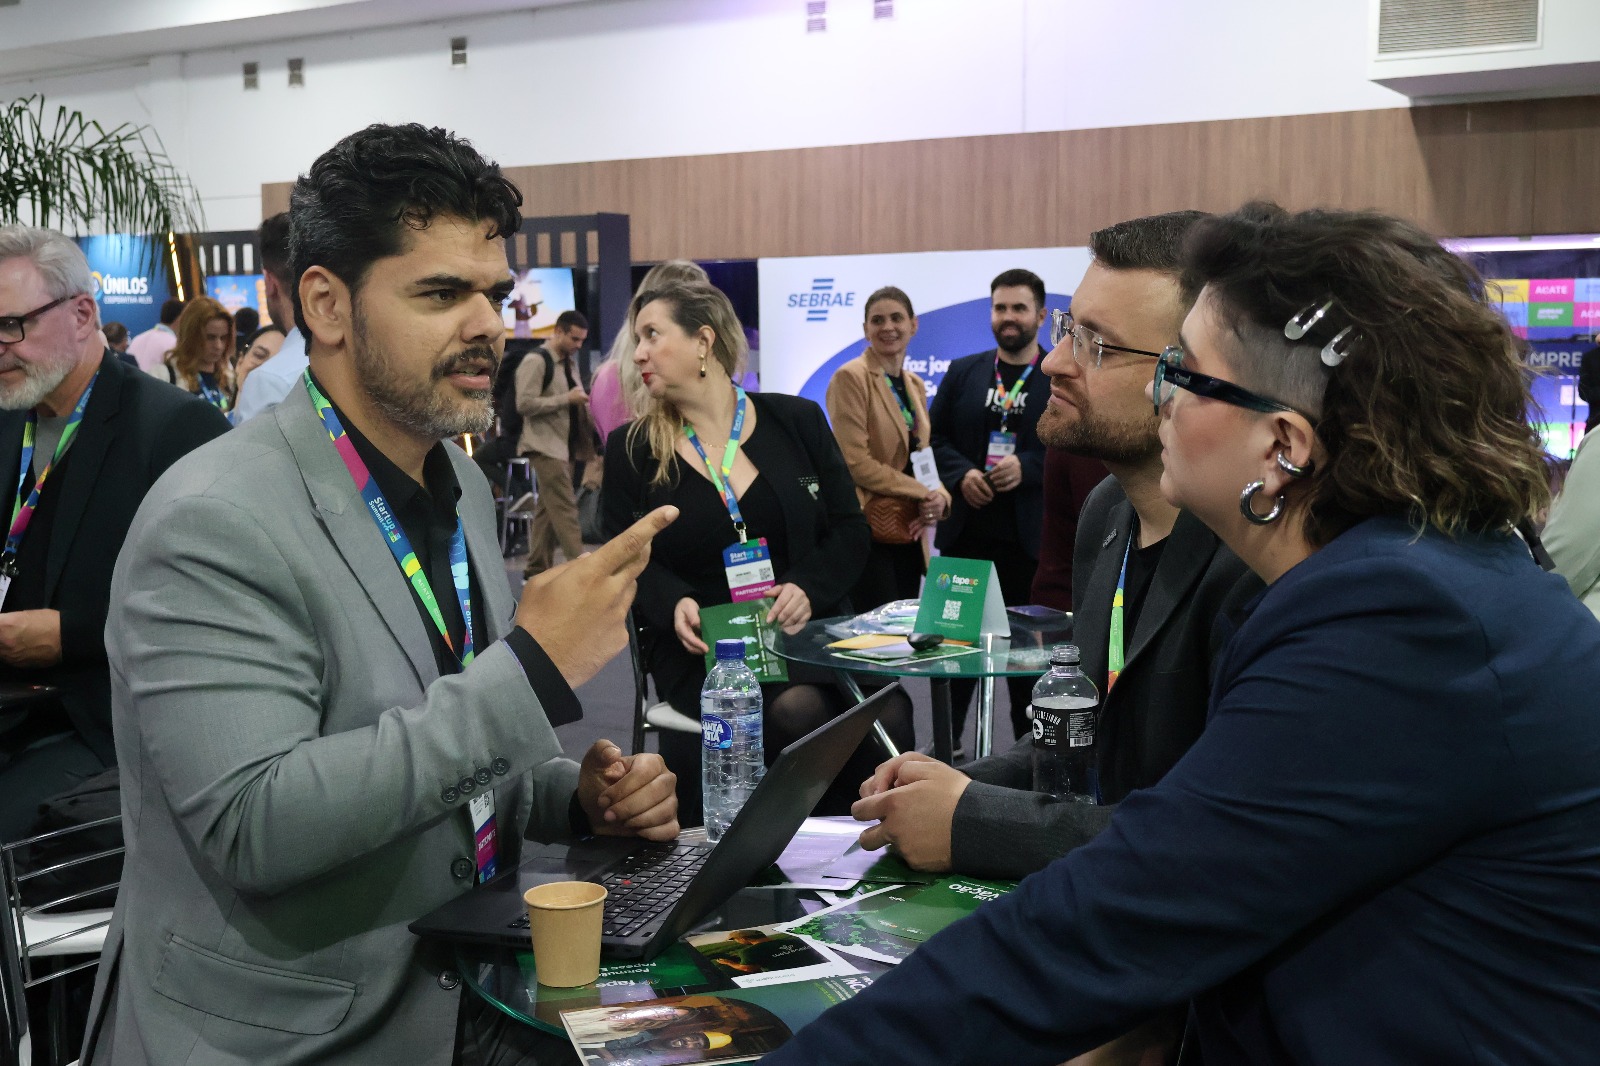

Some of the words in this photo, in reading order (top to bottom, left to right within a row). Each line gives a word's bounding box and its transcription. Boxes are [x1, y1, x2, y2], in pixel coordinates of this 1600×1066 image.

[103, 273, 148, 294] ÚNILOS
[787, 292, 855, 308] SEBRAE
[902, 355, 927, 373] faz
[368, 501, 386, 524] Summit
[374, 496, 396, 529] Startup
[588, 980, 636, 988] fape
